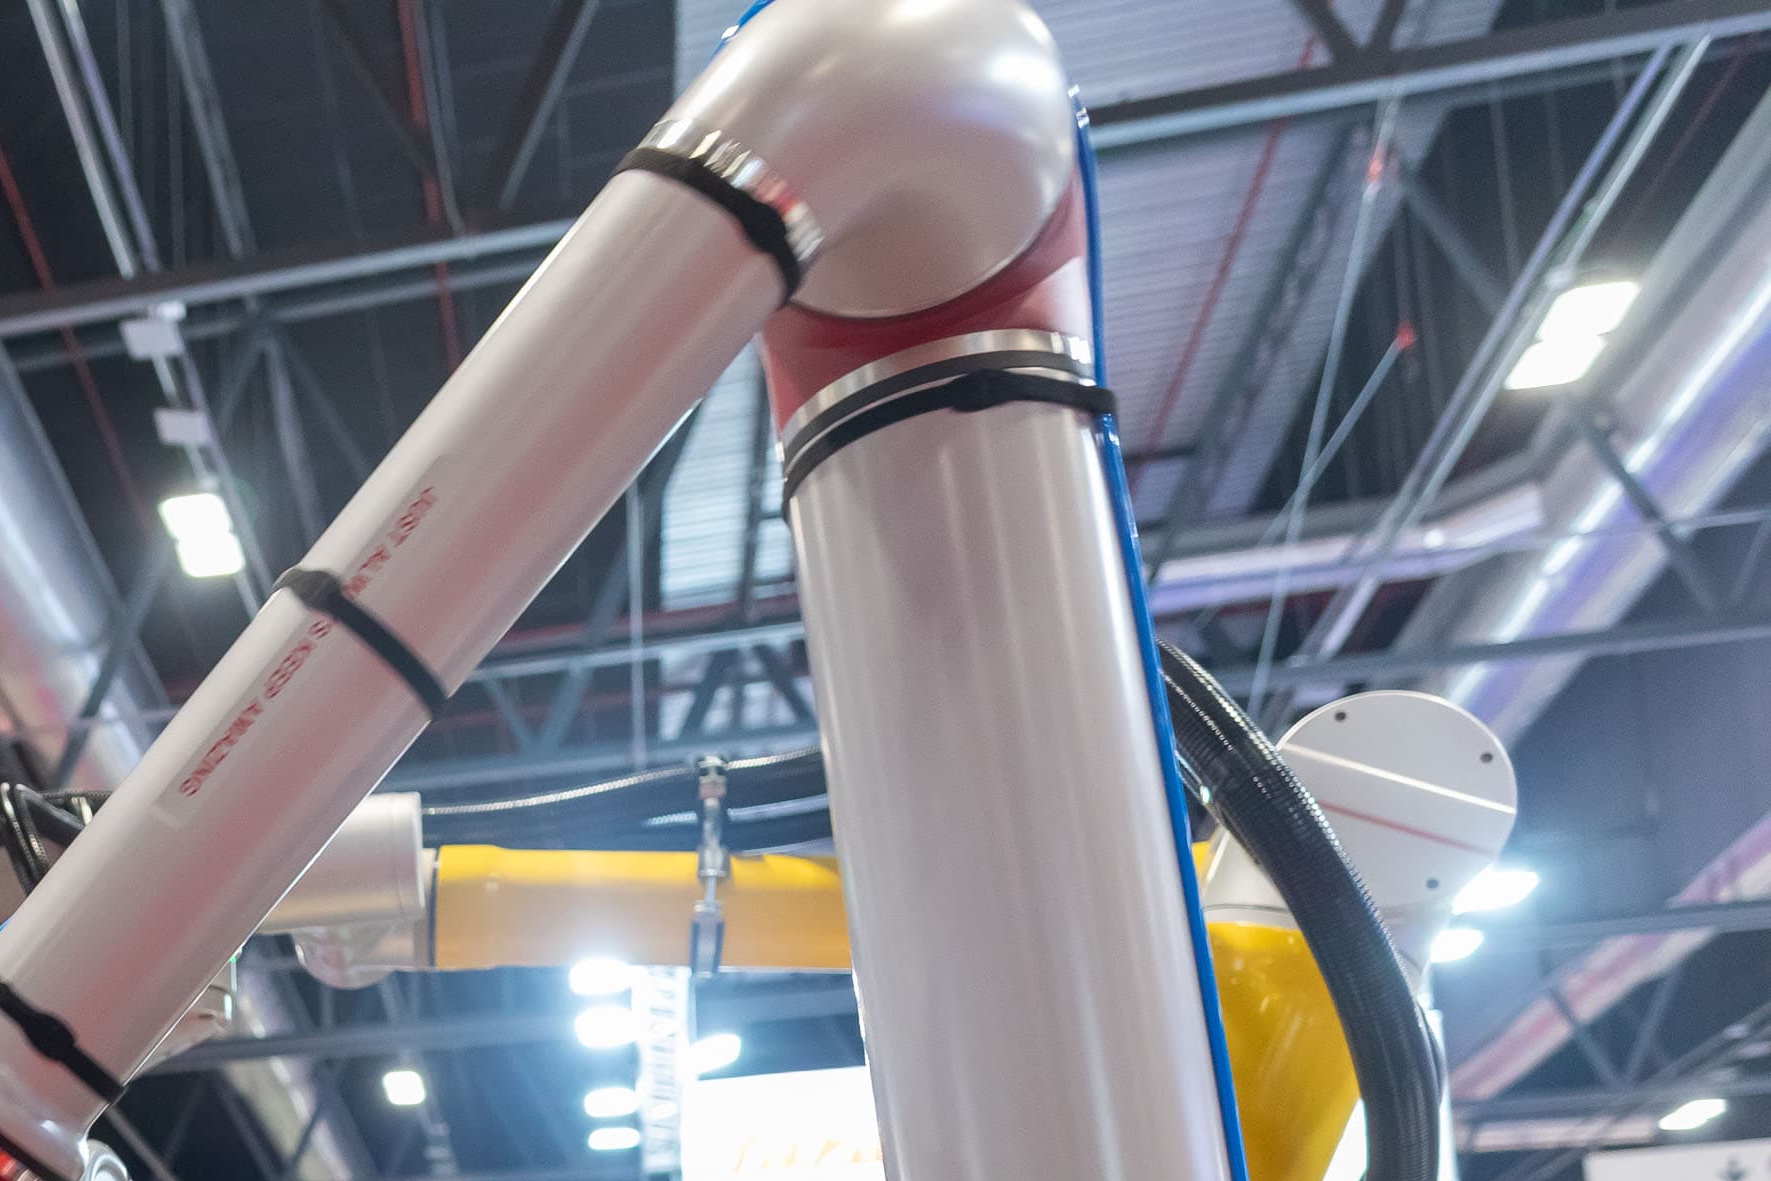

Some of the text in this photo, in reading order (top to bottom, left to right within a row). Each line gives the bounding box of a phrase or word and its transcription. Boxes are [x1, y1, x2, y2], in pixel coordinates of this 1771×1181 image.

[178, 486, 439, 799] JUST ALWS KEEP AMAZING
